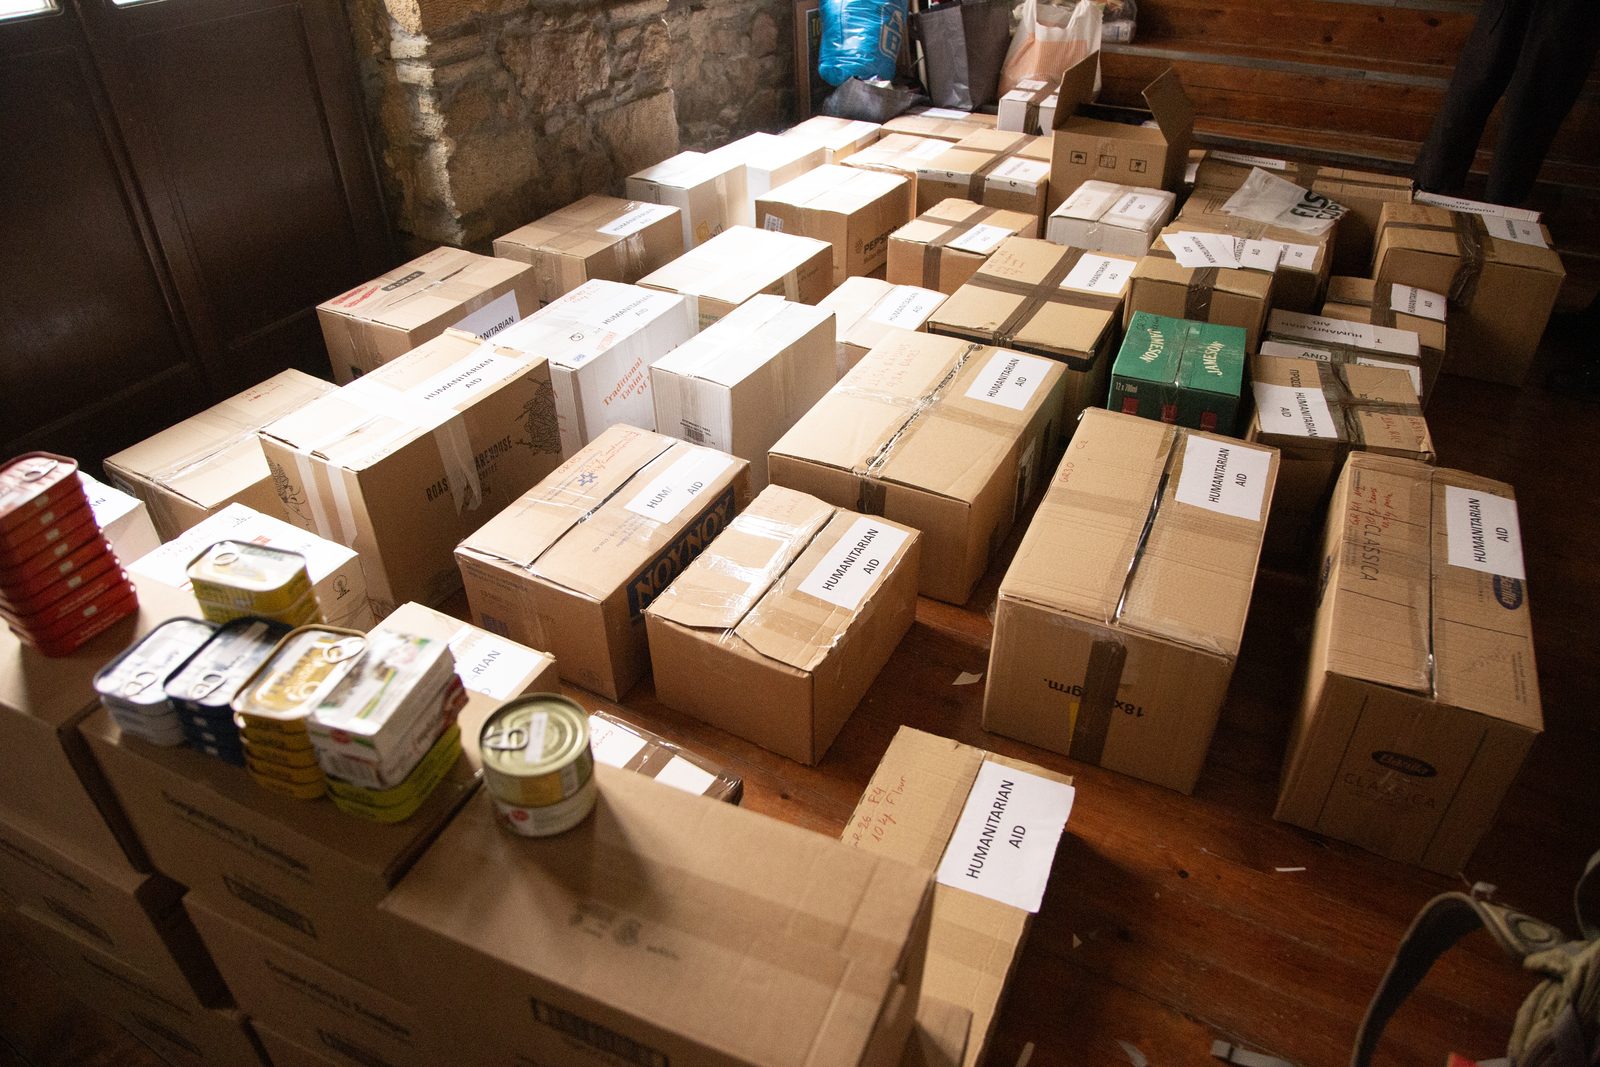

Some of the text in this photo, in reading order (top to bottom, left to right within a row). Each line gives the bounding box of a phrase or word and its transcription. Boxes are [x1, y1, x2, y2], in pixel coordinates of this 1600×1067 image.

[474, 315, 515, 341] ANITARIAN
[1139, 328, 1165, 363] JAMESON
[1281, 321, 1363, 339] HUMANITARIAN
[1203, 341, 1225, 376] JAMESON
[424, 357, 494, 400] HUMANITARIAN
[465, 377, 483, 388] AID
[602, 357, 643, 407] Traditional
[621, 373, 644, 401] Tahini
[986, 358, 1020, 398] HUMANITARIAN
[1015, 376, 1027, 388] AID
[1280, 406, 1292, 418] AID
[1295, 391, 1319, 438] HUMANITARIAN
[474, 434, 513, 472] AREHOUSE
[687, 481, 704, 495] AID
[1208, 447, 1230, 504] HUMANITARIAN
[1235, 473, 1247, 488] AID
[1468, 497, 1487, 564] HUMANITARIAN
[1497, 527, 1510, 543] AID
[822, 528, 879, 591] HUMANITARIAN
[863, 558, 880, 575] AID
[1359, 523, 1382, 582] CLASSICA
[965, 780, 1015, 880] HUMANITARIAN
[1008, 825, 1026, 849] AID
